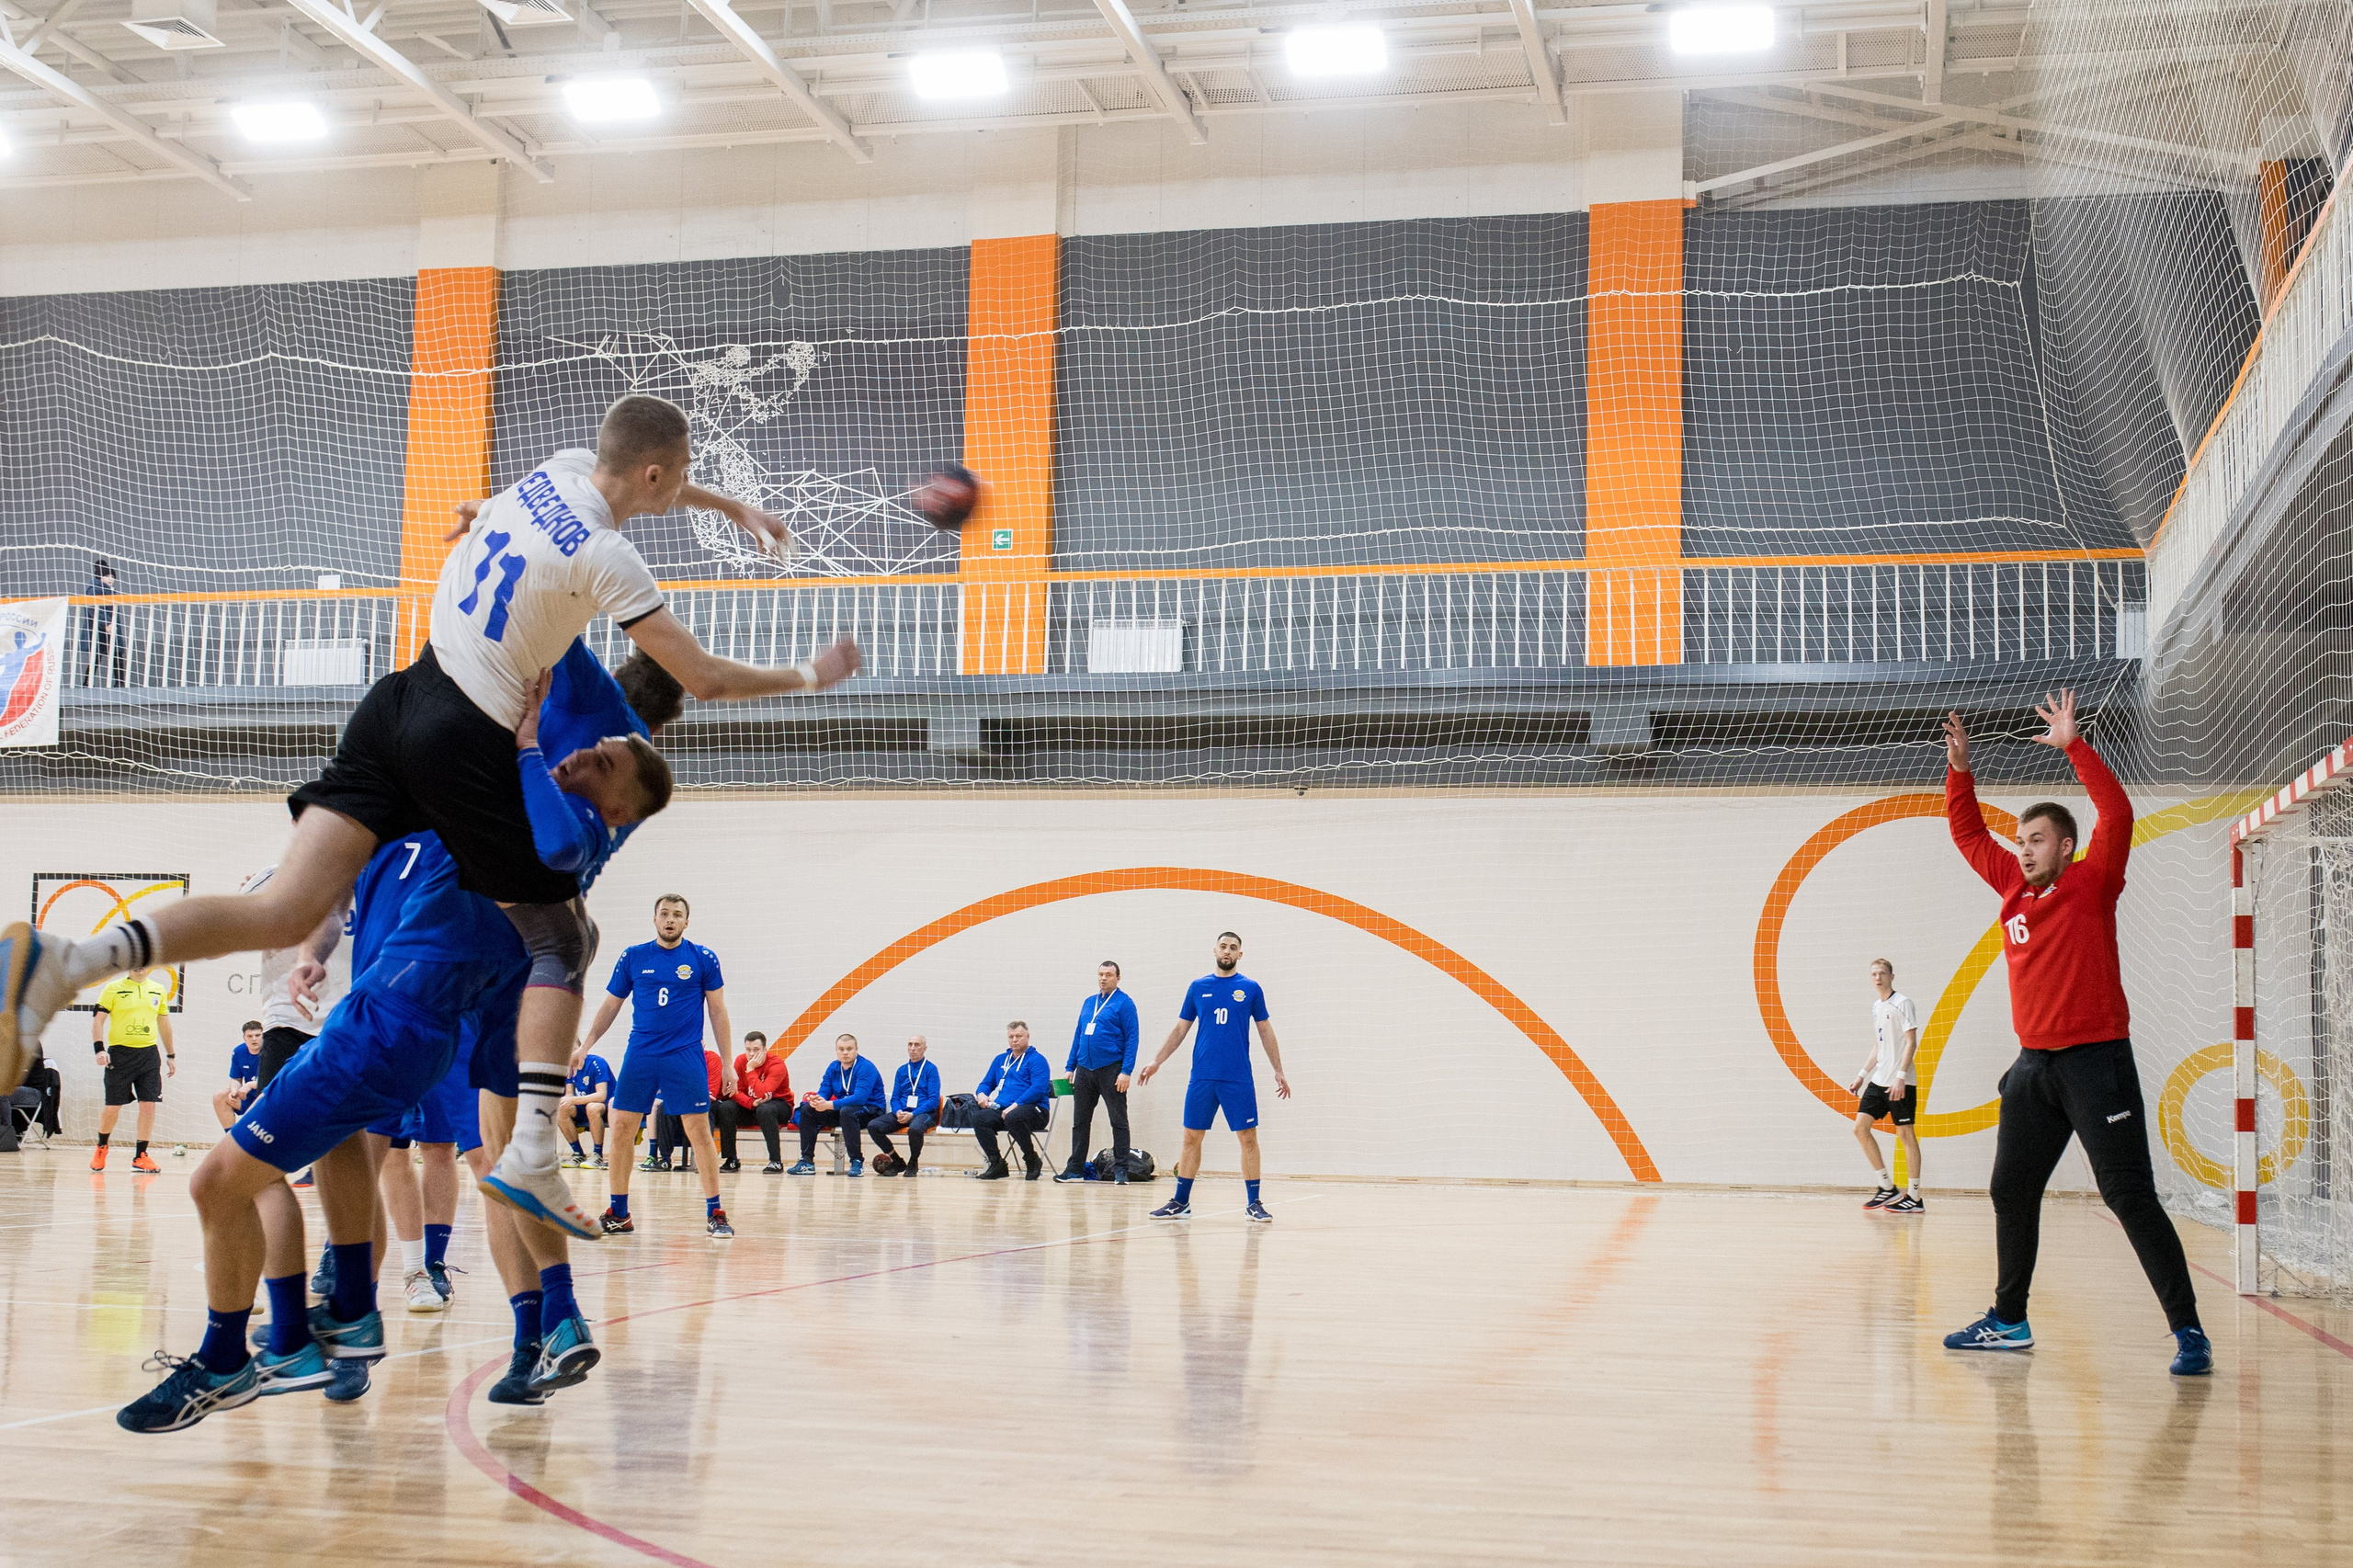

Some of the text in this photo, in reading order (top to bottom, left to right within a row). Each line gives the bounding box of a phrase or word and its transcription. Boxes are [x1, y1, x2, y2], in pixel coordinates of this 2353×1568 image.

[458, 529, 527, 642] 11
[4, 693, 49, 738] FEDERATION
[44, 678, 54, 693] OF
[398, 843, 421, 880] 7
[2005, 913, 2030, 945] 16
[657, 987, 669, 1006] 6
[1213, 1007, 1228, 1025] 10
[246, 1120, 275, 1144] JAKO
